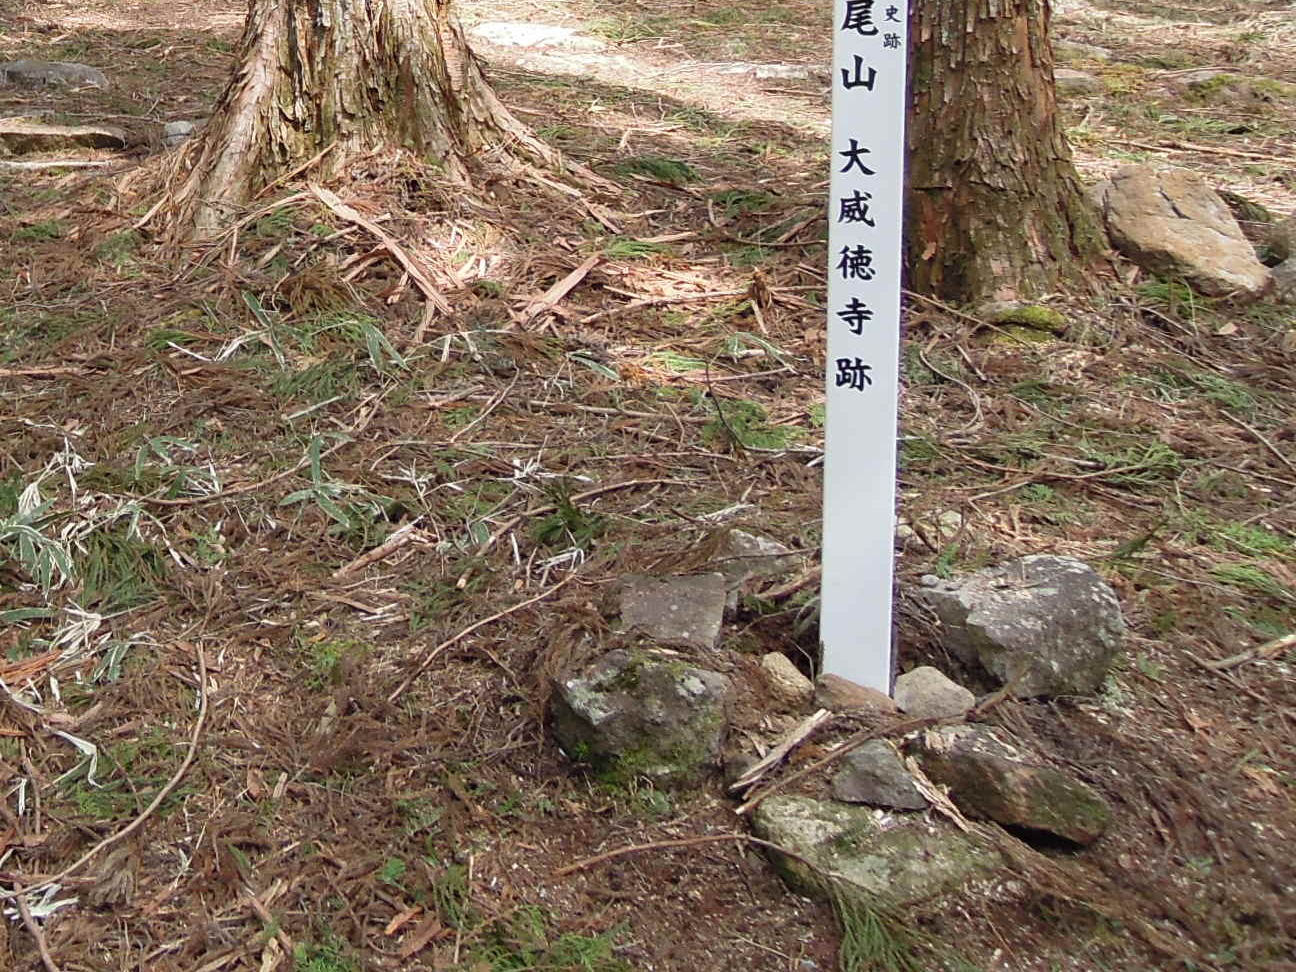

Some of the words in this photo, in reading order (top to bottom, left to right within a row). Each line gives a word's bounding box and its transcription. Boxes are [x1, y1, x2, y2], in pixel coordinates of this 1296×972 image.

[835, 138, 877, 392] 大威徳寺跡
